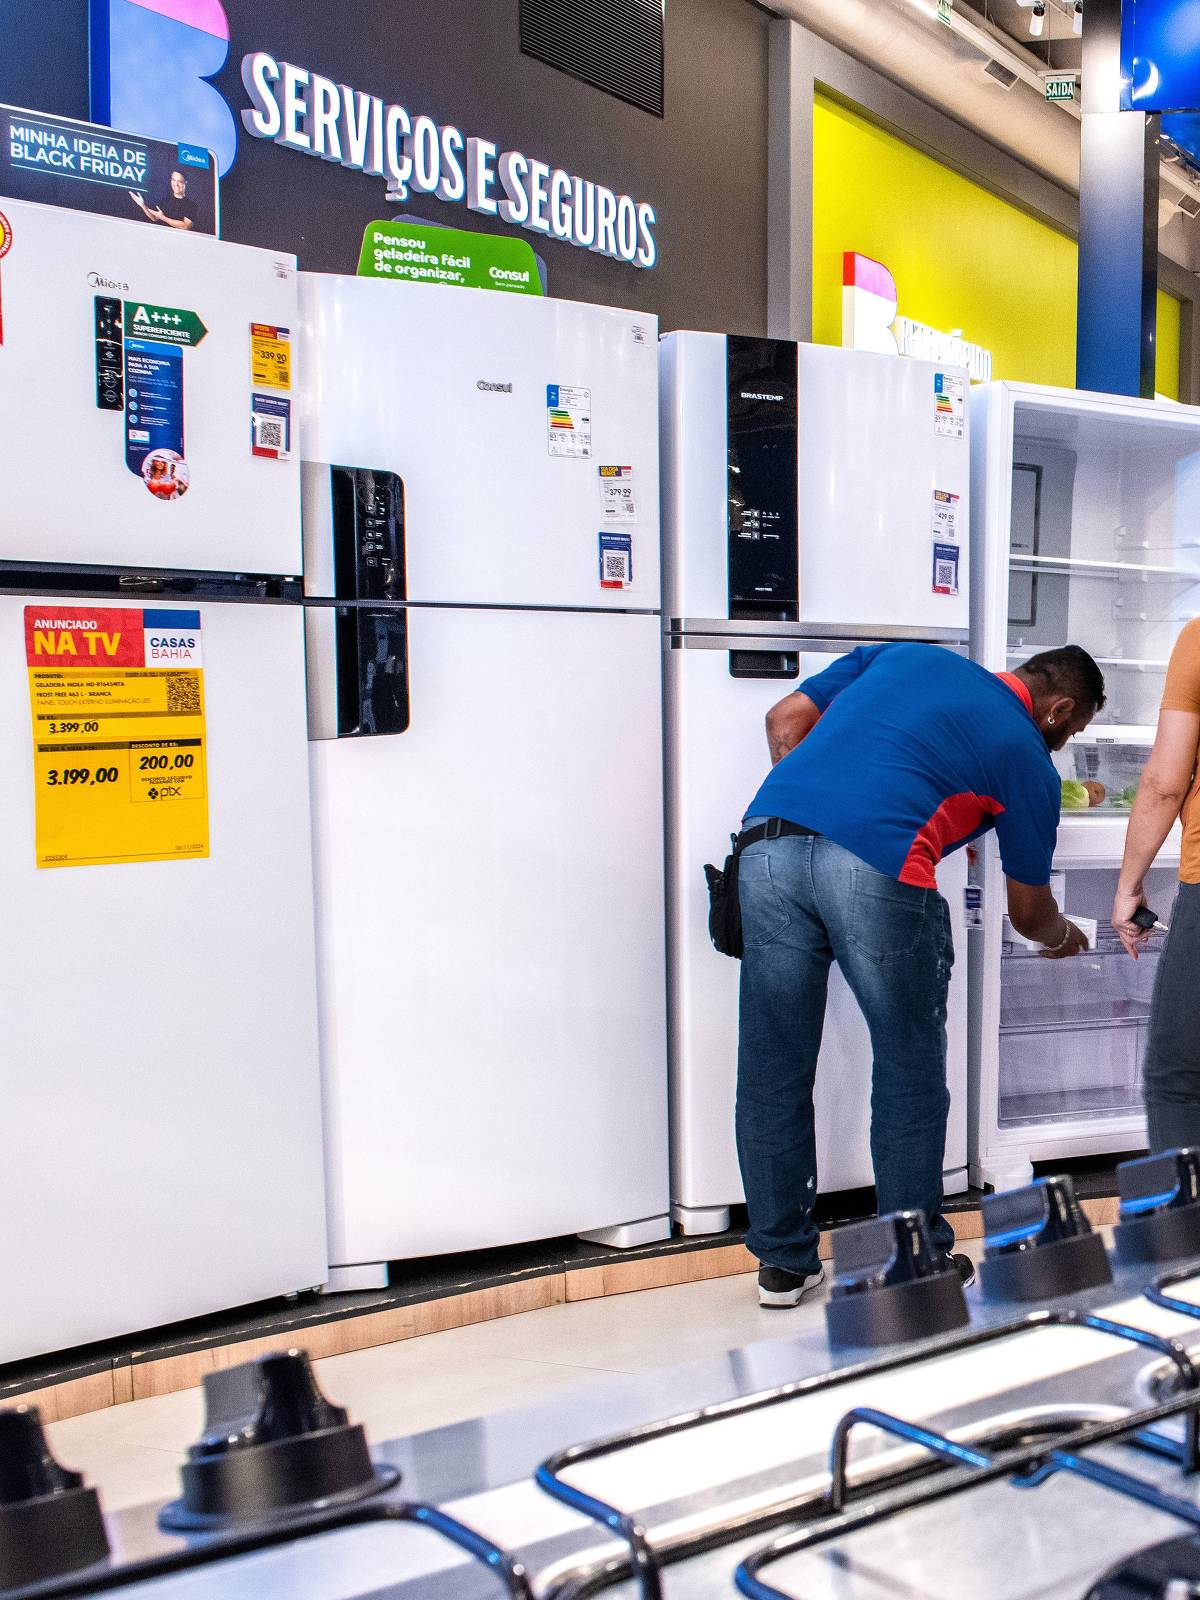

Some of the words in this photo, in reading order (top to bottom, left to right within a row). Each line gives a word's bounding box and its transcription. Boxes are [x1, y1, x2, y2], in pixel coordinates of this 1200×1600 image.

[1047, 81, 1073, 97] SAÍDA
[10, 125, 68, 150] MINHA
[74, 138, 119, 161] IDEIA
[123, 149, 147, 166] DE
[10, 142, 75, 169] BLACK
[80, 156, 146, 183] FRIDAY
[243, 52, 466, 201] SERVIÇOS
[467, 137, 499, 216] E
[498, 151, 657, 268] SEGUROS
[373, 232, 426, 249] Pensou
[373, 247, 439, 266] geladeira
[442, 253, 471, 269] fácil
[374, 260, 392, 273] de
[394, 263, 465, 284] organizar,
[489, 266, 529, 283] Consul
[133, 305, 182, 326] A+++
[133, 323, 190, 339] SUPEREFICIENTE
[476, 380, 512, 393] Consul
[741, 392, 784, 401] BRASTEMP
[34, 619, 97, 629] ANUNCIADO
[34, 631, 77, 655] NA
[83, 632, 121, 655] TV
[150, 637, 195, 648] CASAS
[151, 648, 192, 659] BAHIA
[49, 721, 99, 734] 3.399,00
[139, 754, 194, 770] 200,00
[46, 767, 119, 786] 3.199,00
[160, 786, 181, 800] pix
